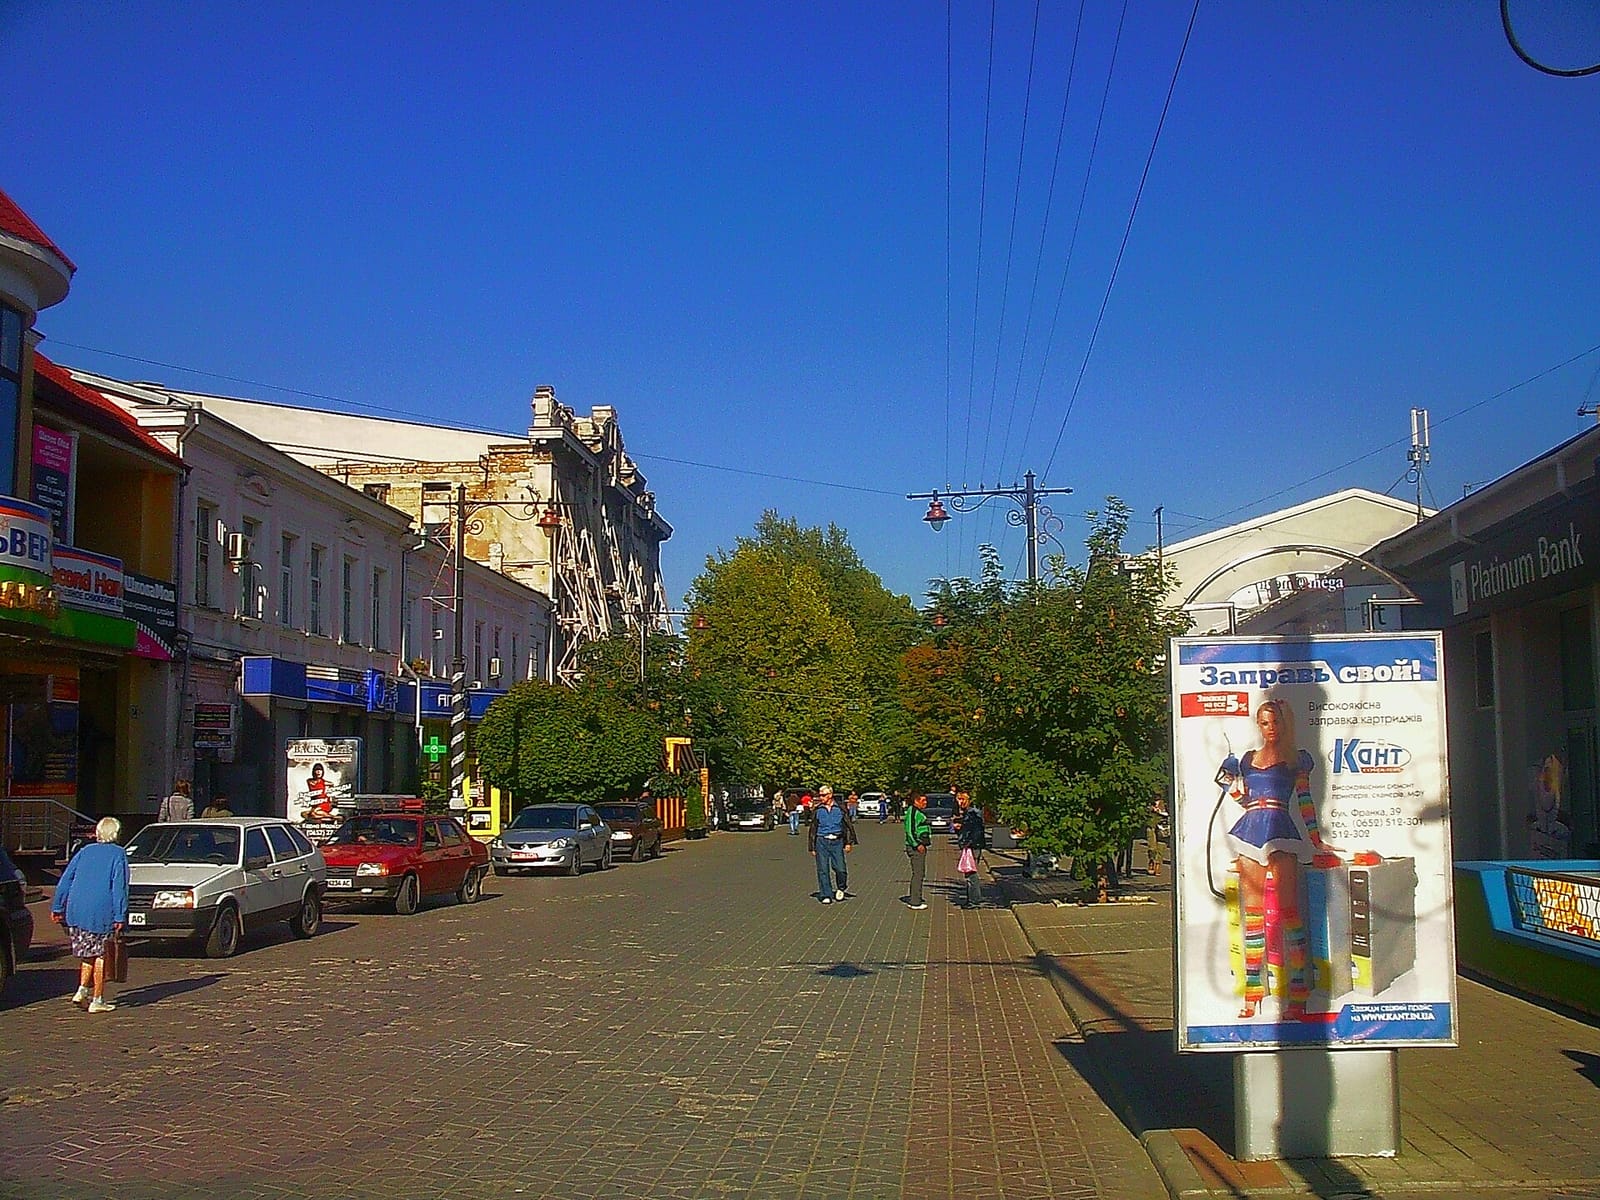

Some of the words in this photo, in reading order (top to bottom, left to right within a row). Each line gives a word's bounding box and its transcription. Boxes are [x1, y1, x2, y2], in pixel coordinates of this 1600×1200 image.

[1471, 554, 1536, 601] Platinum
[1538, 522, 1584, 578] Bank
[1200, 665, 1330, 689] Заправь
[1339, 659, 1421, 682] свой!
[1309, 701, 1382, 712] Високоякісна
[1309, 716, 1358, 728] заправка
[1360, 713, 1423, 727] картриджів
[1333, 737, 1403, 774] Кант
[1331, 829, 1371, 839] 512-302
